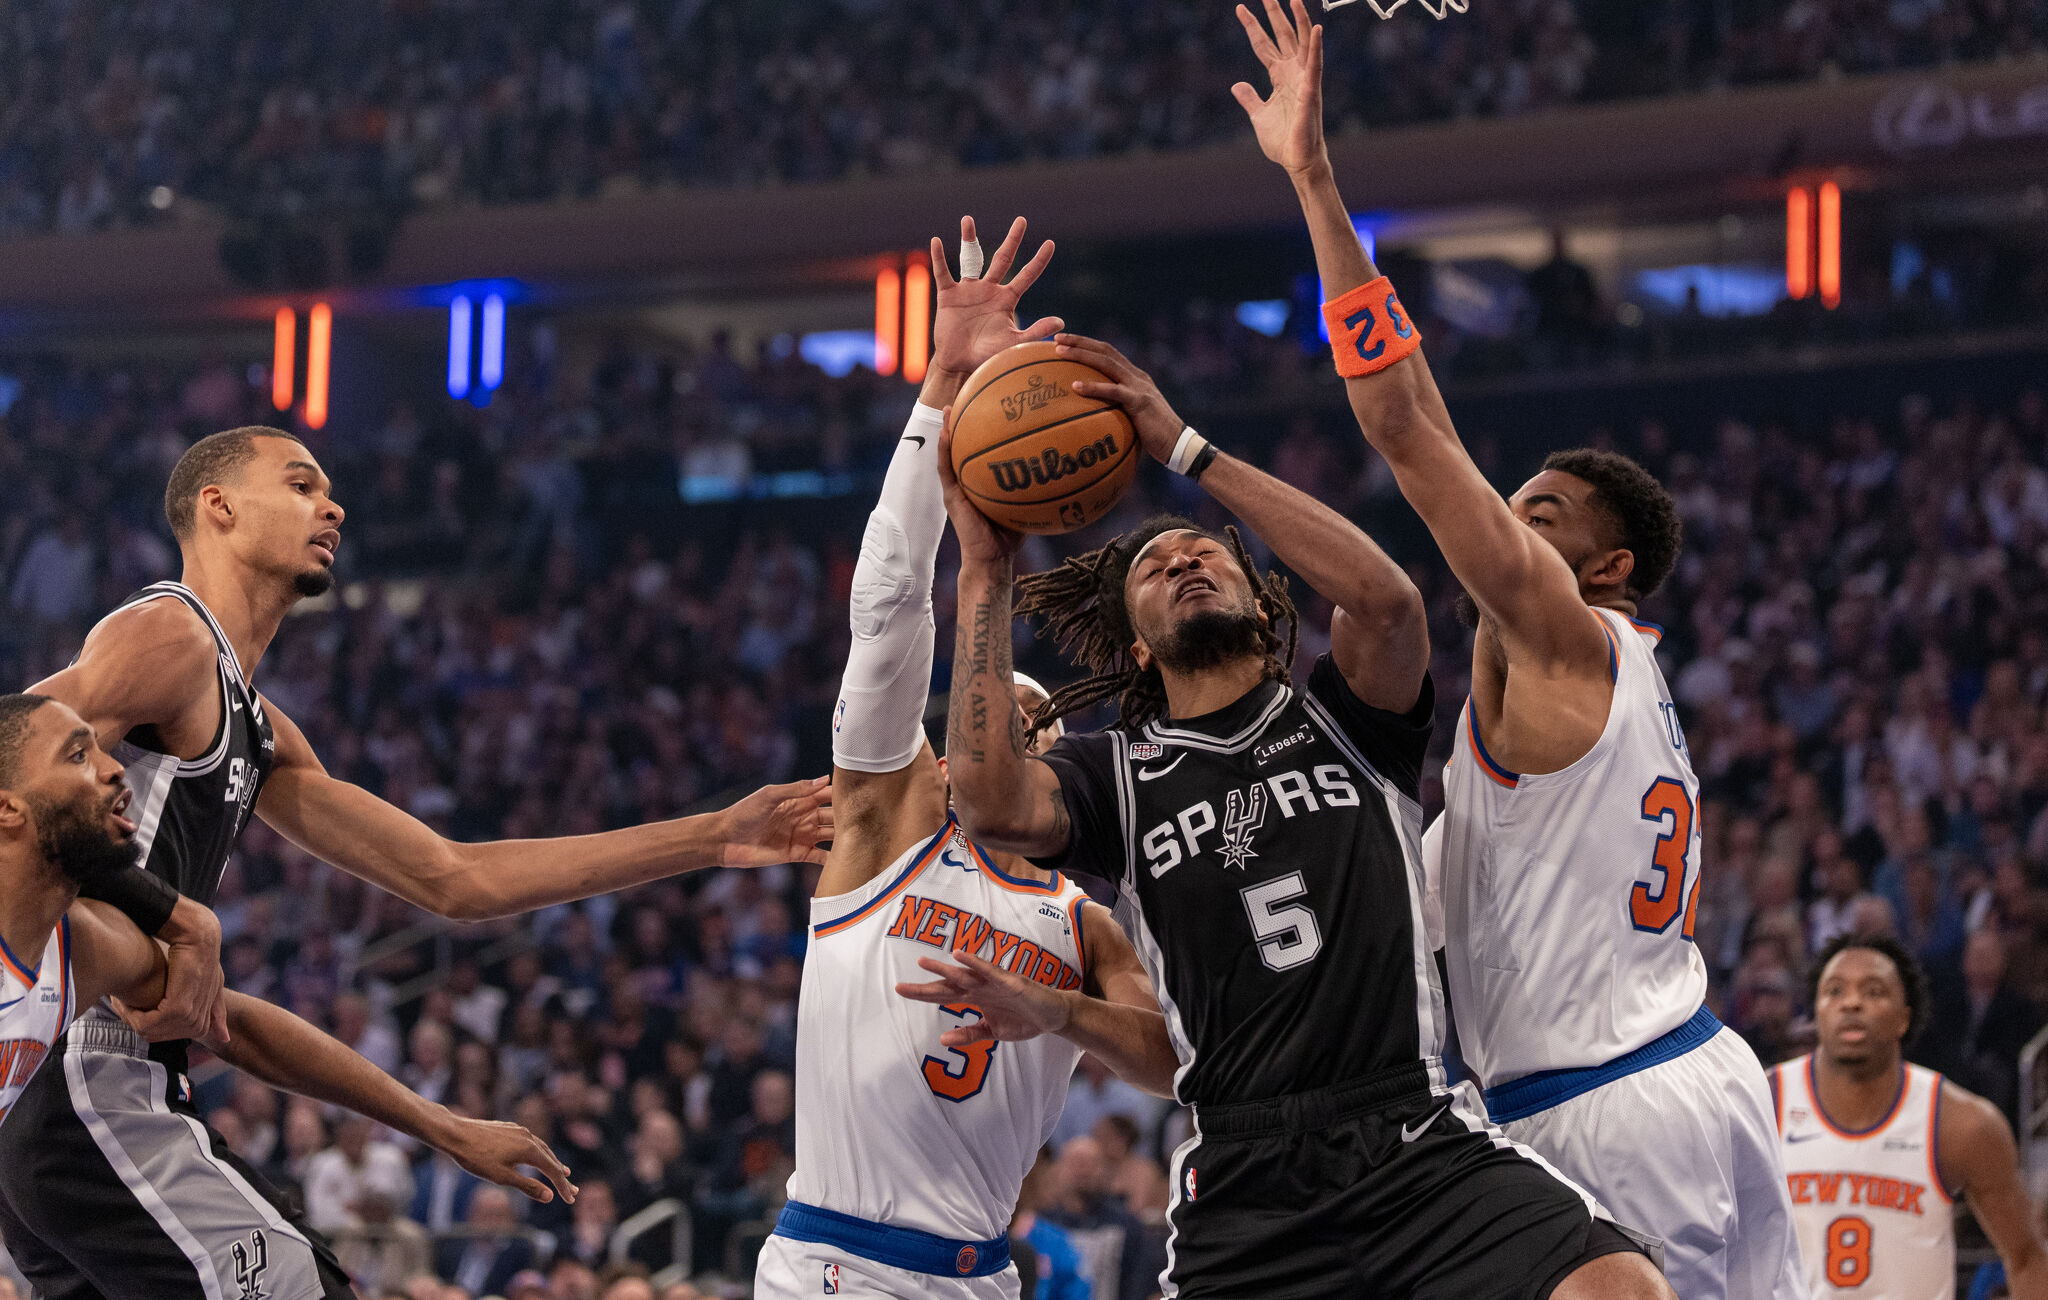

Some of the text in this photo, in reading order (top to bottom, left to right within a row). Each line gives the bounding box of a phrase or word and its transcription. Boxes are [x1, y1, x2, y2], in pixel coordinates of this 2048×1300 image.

[1013, 381, 1069, 422] Finals
[987, 434, 1119, 492] Wilson
[972, 694, 987, 732] XXV
[1261, 732, 1305, 757] LEDGER
[1143, 764, 1360, 879] SPURS
[1629, 775, 1701, 942] 3
[885, 894, 1082, 991] NEW YORK
[1038, 908, 1060, 920] abu
[1239, 870, 1323, 973] 5
[921, 1003, 1000, 1103] 3
[1786, 1171, 1926, 1217] EW YORK
[1825, 1213, 1874, 1290] 8
